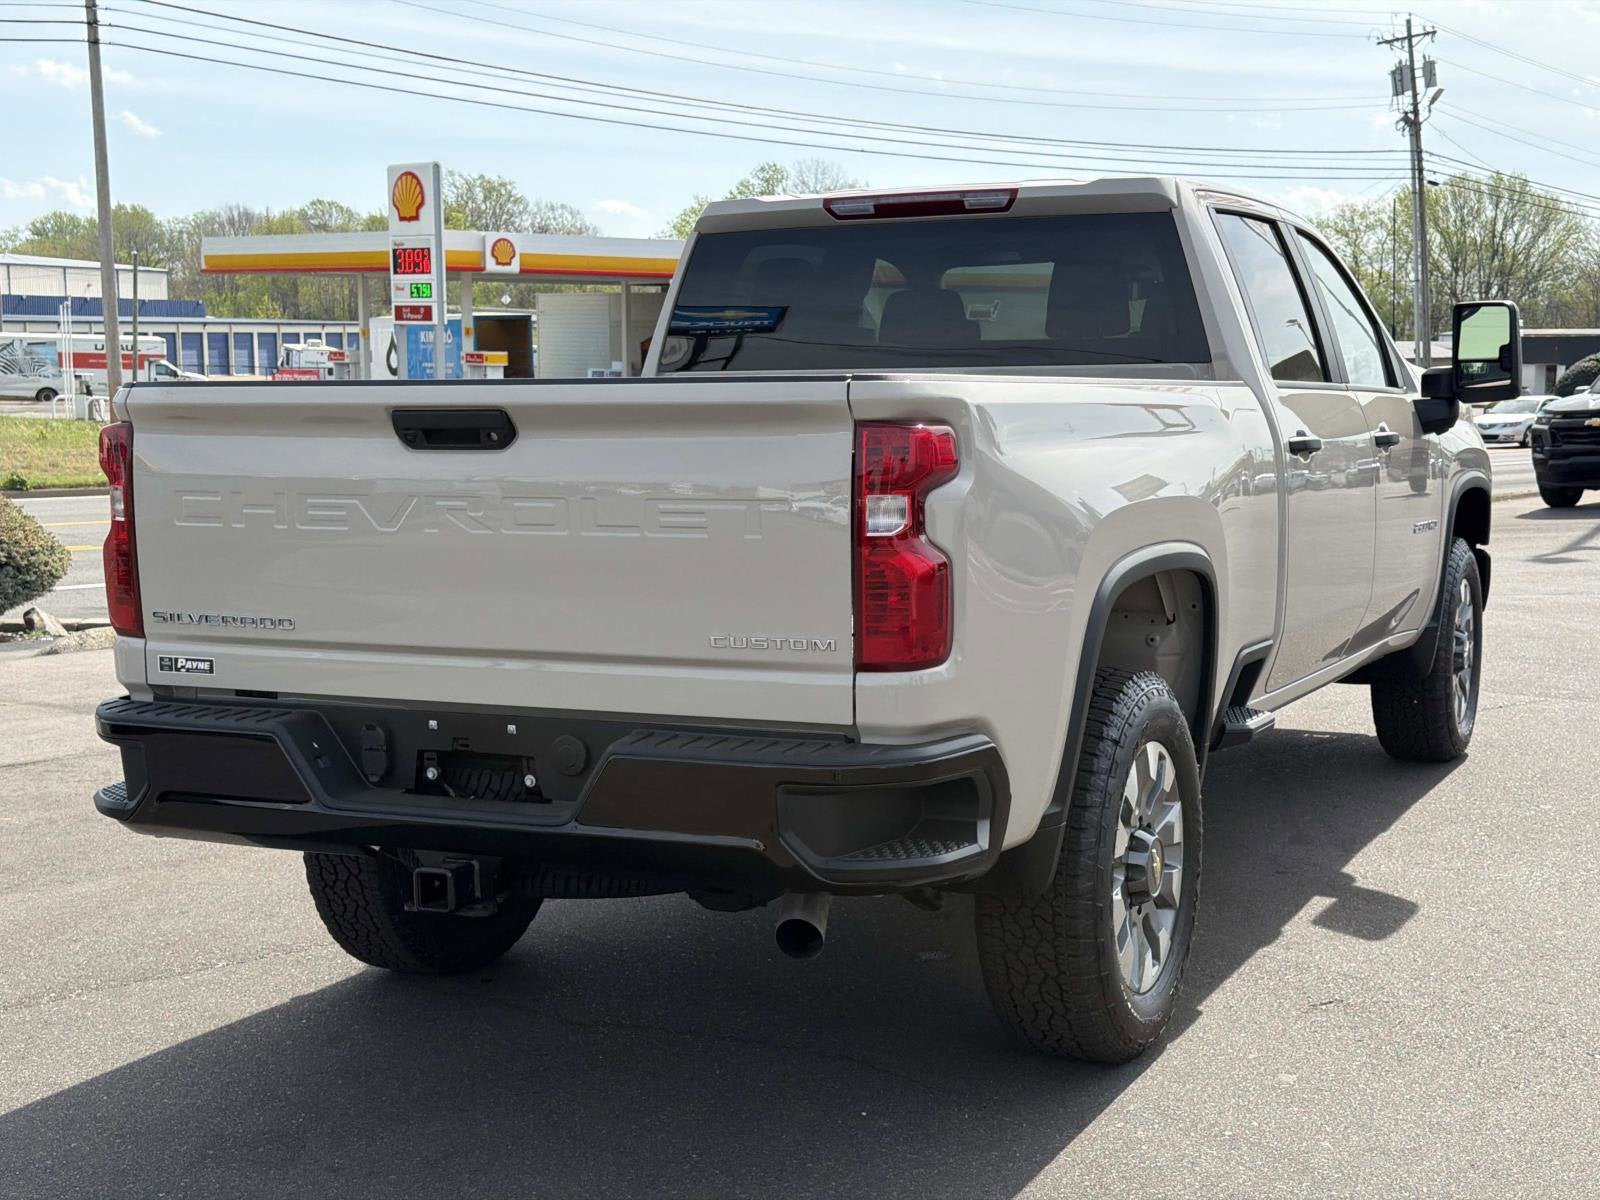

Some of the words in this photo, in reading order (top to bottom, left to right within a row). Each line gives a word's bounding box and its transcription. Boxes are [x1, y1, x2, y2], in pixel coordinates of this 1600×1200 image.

[174, 489, 796, 540] CHEVROLET
[152, 611, 295, 630] SILVERADO
[709, 635, 837, 652] CUSTOM
[177, 658, 210, 670] PAYNE
